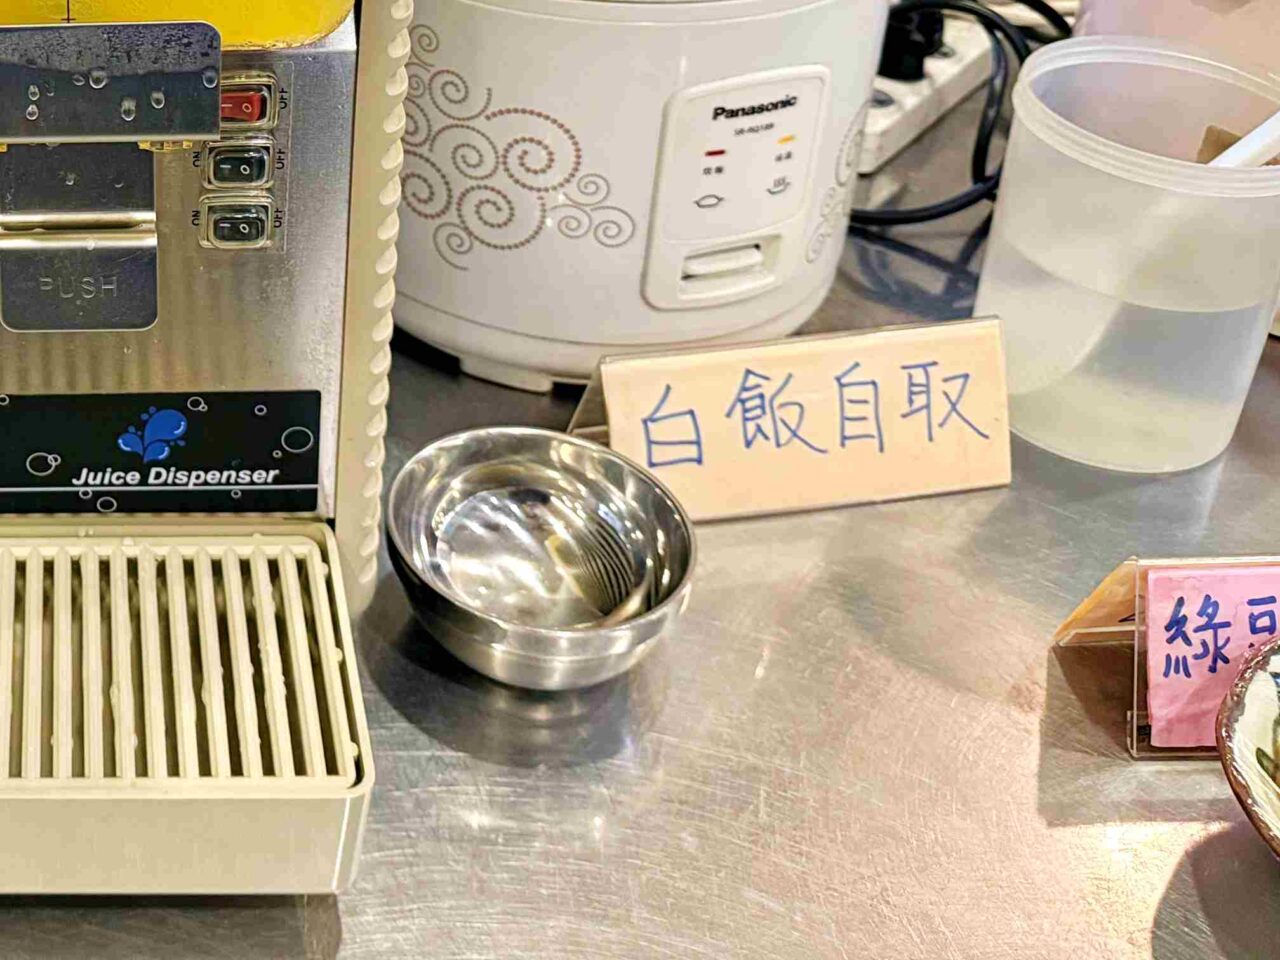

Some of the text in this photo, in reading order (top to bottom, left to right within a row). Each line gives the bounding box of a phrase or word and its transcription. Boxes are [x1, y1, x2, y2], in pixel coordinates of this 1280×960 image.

[712, 94, 797, 120] Panasonic
[39, 276, 117, 298] PUSH
[641, 361, 990, 468] 白飯自取
[72, 467, 280, 489] Juice Dispenser
